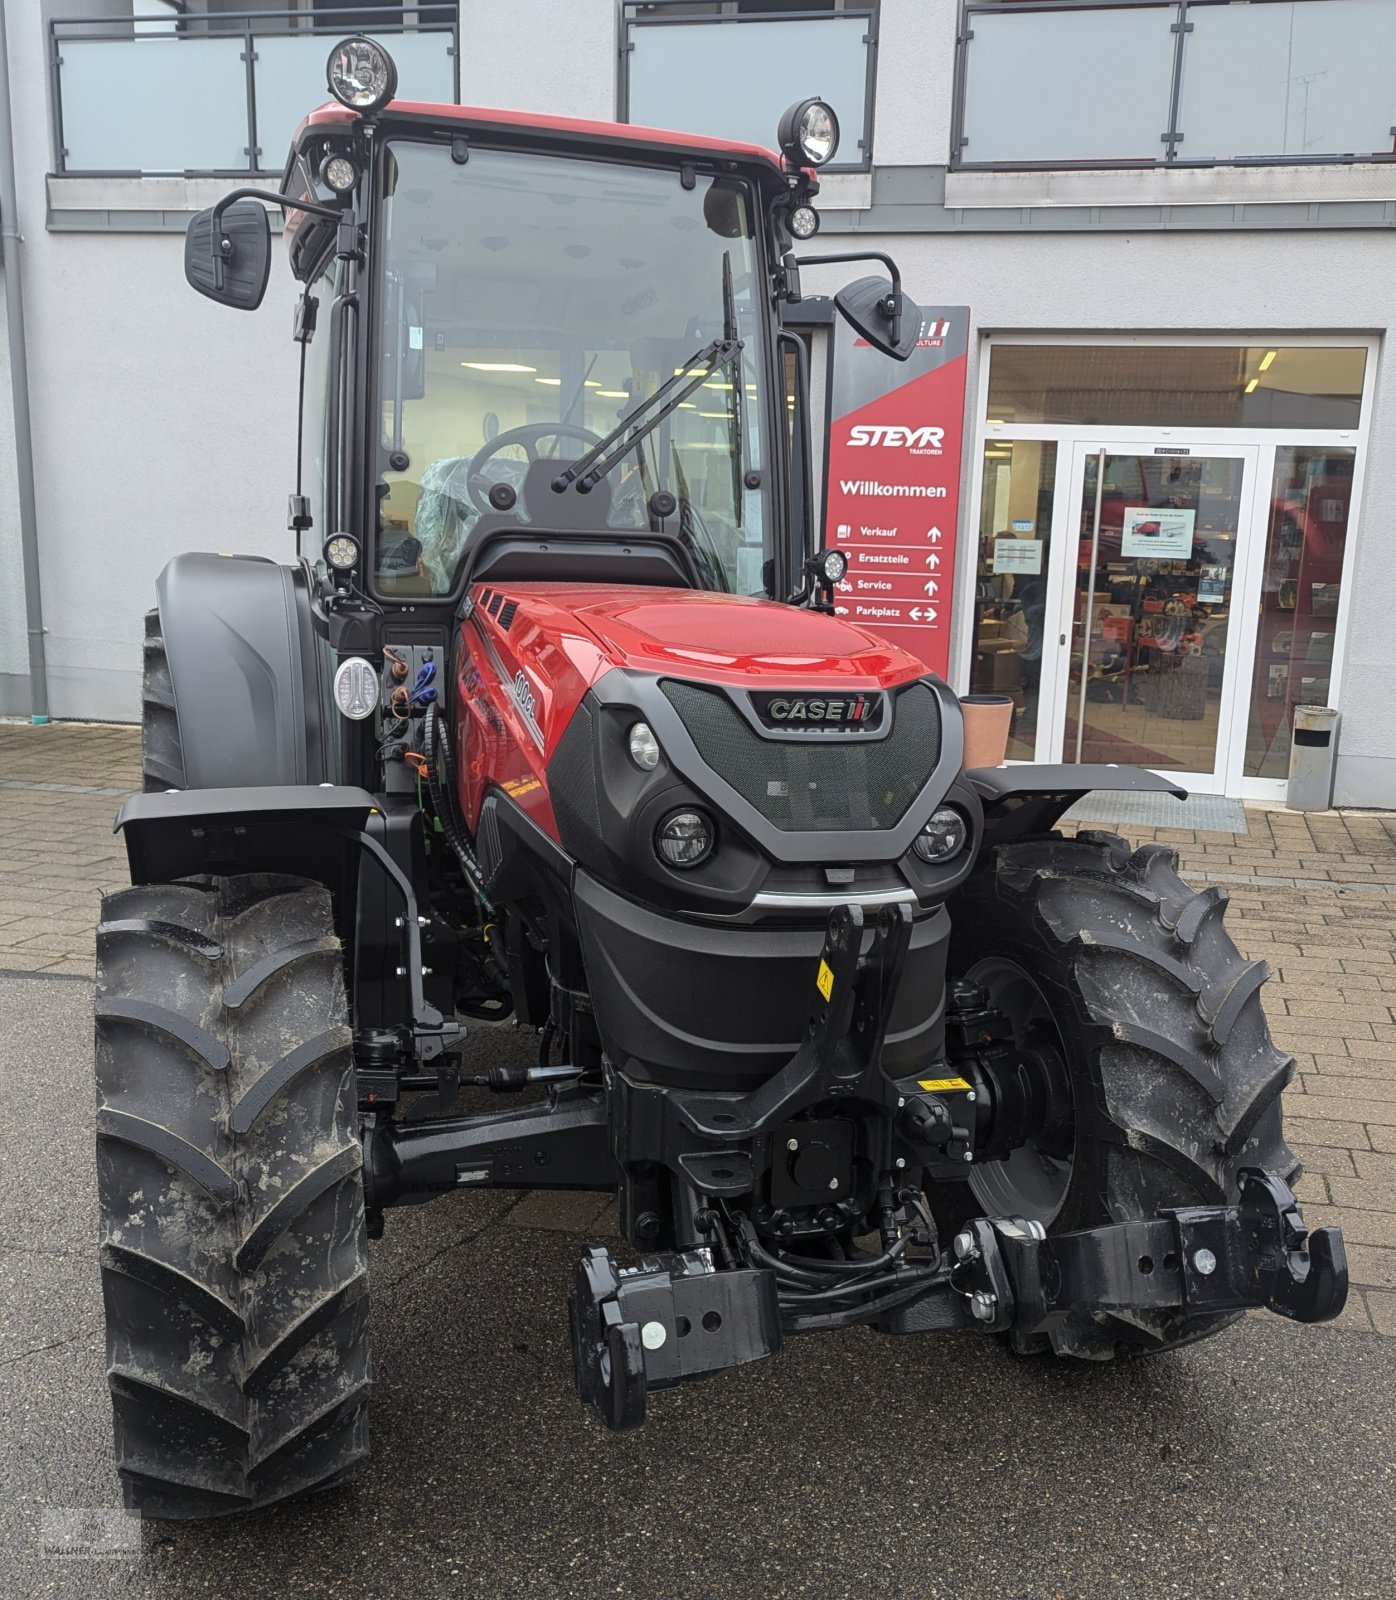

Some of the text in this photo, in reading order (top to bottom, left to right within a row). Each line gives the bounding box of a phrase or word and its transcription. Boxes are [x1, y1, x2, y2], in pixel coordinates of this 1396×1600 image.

[846, 425, 945, 448] STEYR
[909, 448, 943, 456] TRAKTOREN
[839, 480, 947, 498] Willkommen
[860, 526, 898, 537] Verkauf
[858, 553, 909, 565] Ersatzteile
[857, 580, 893, 590] Service
[856, 606, 901, 617] Parkplatz
[770, 700, 845, 720] CASE
